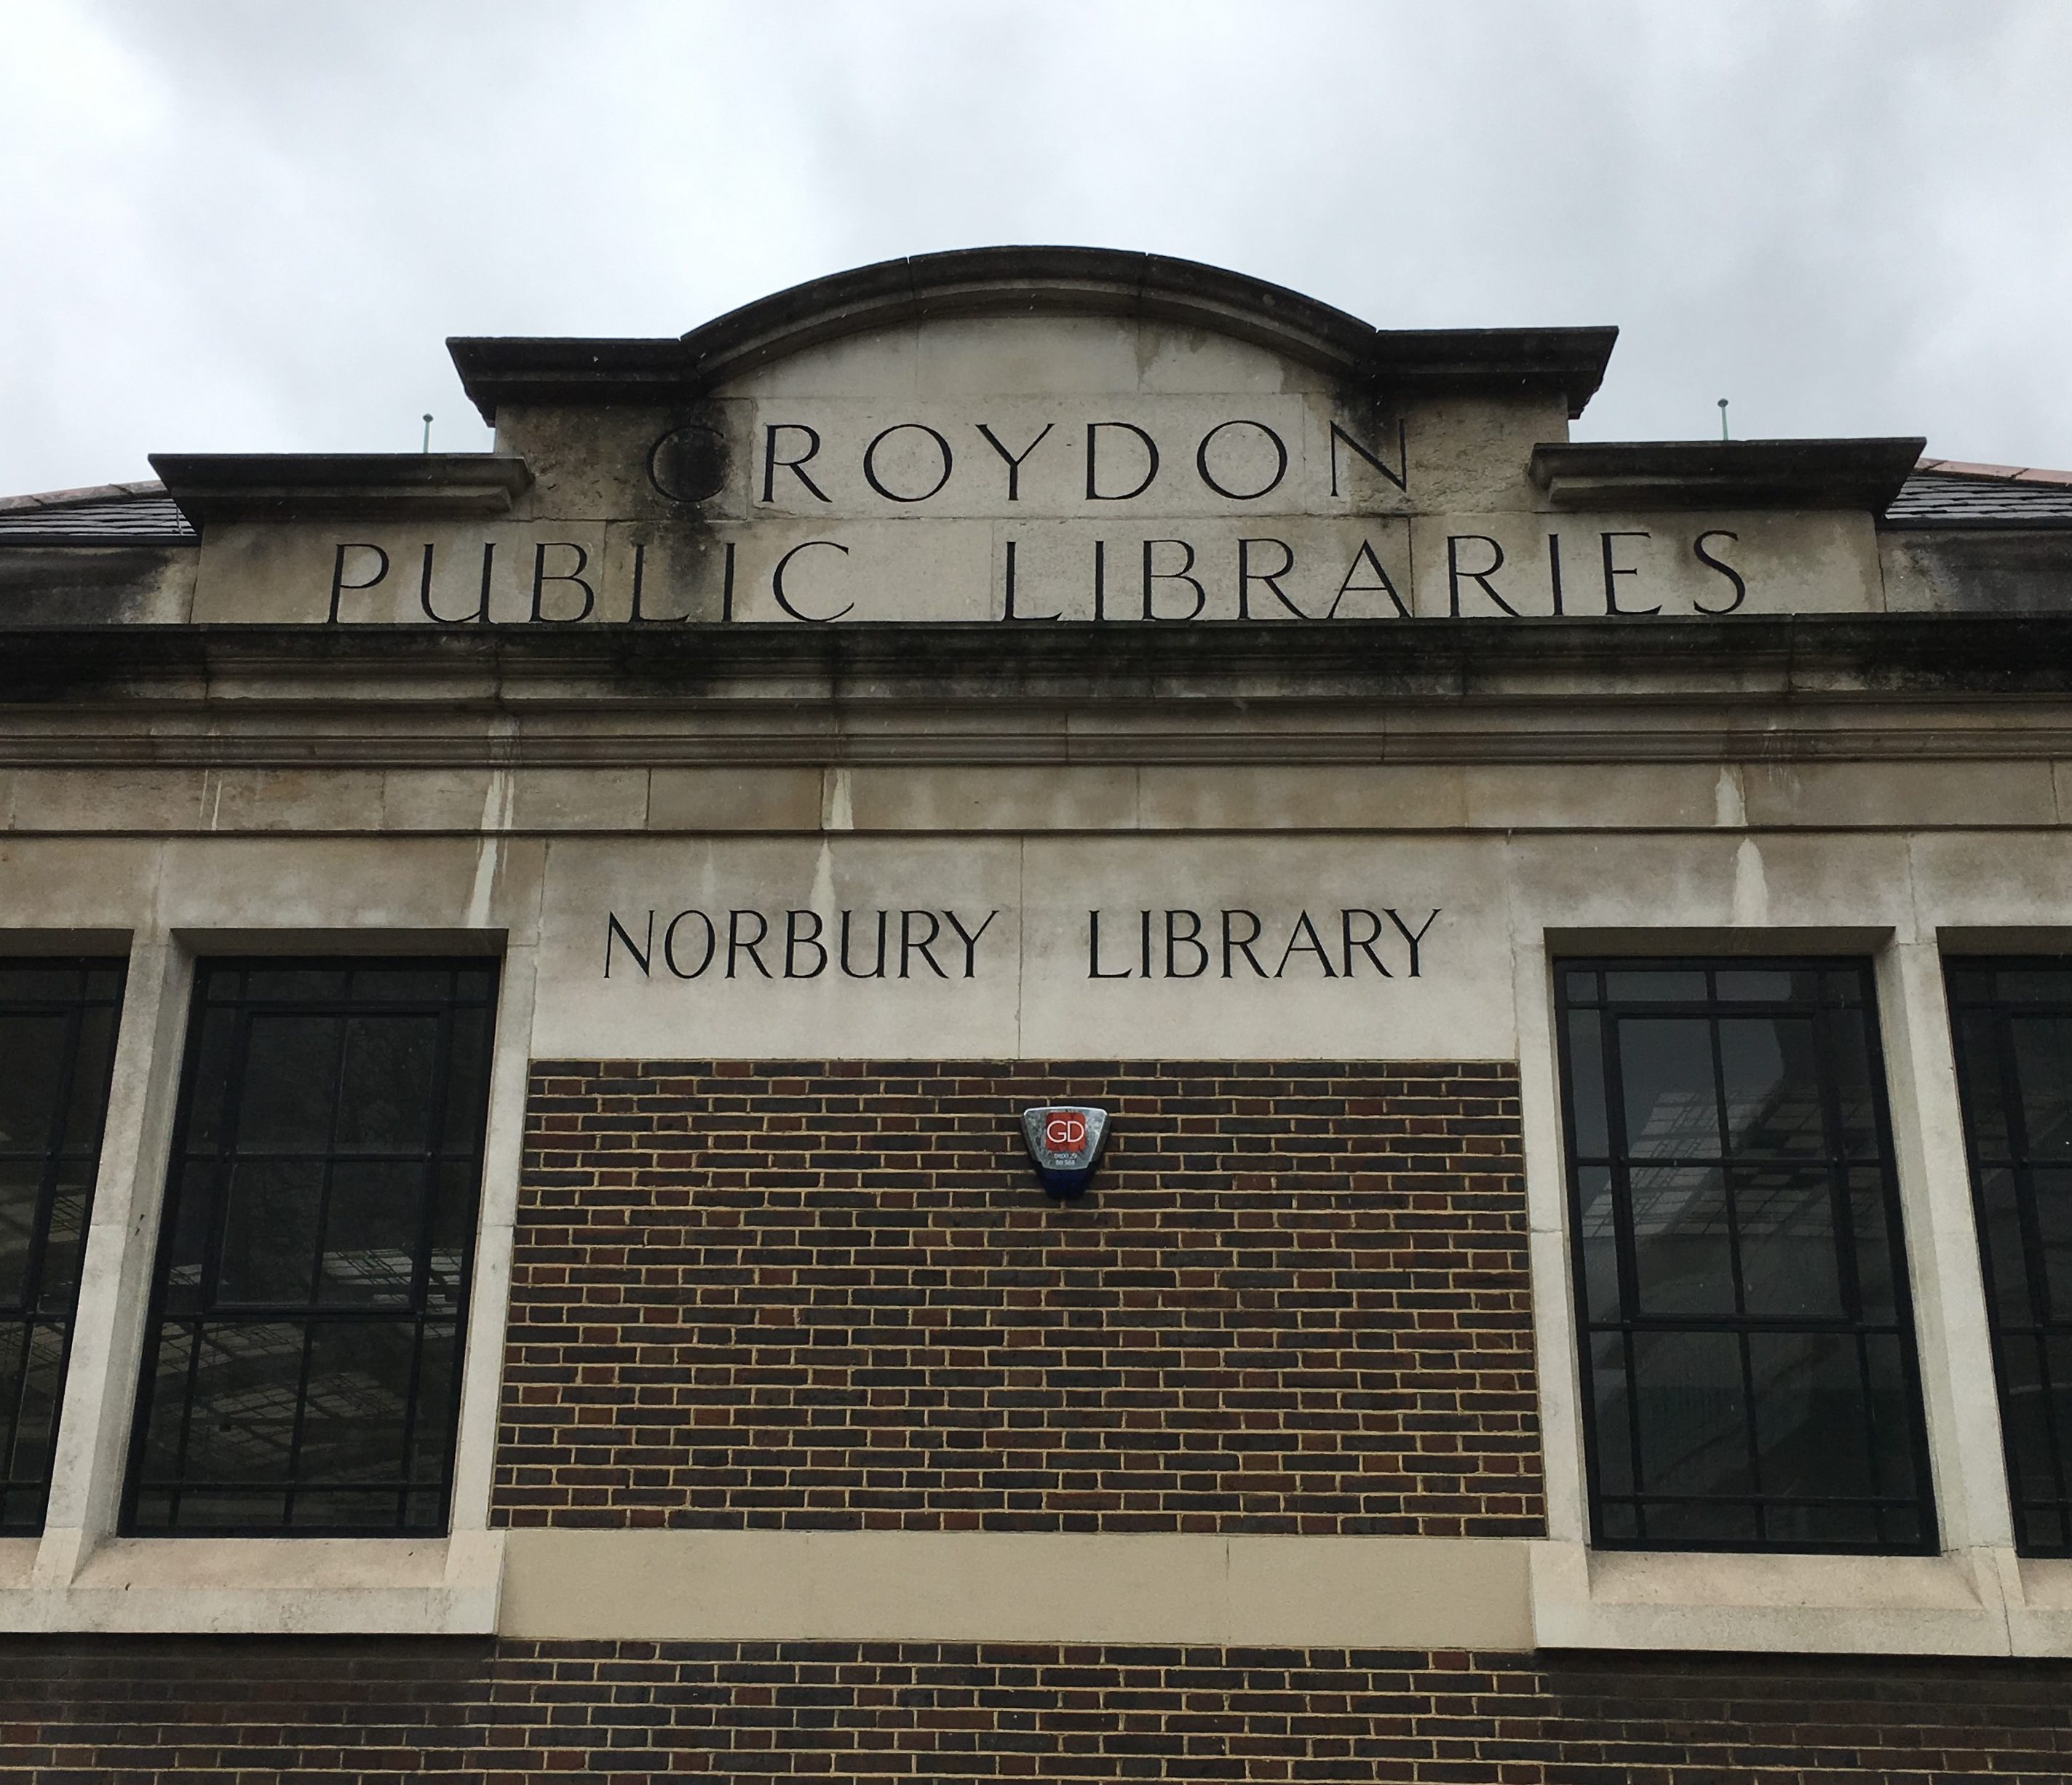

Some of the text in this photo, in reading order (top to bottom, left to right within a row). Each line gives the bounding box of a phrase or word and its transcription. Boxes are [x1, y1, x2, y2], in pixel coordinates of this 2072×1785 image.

[646, 418, 1407, 504] CROYDON
[327, 530, 1747, 624] PUBLIC LIBRARIES
[603, 907, 1442, 979] NORBURY LIBRARY
[1047, 1120, 1084, 1143] GD
